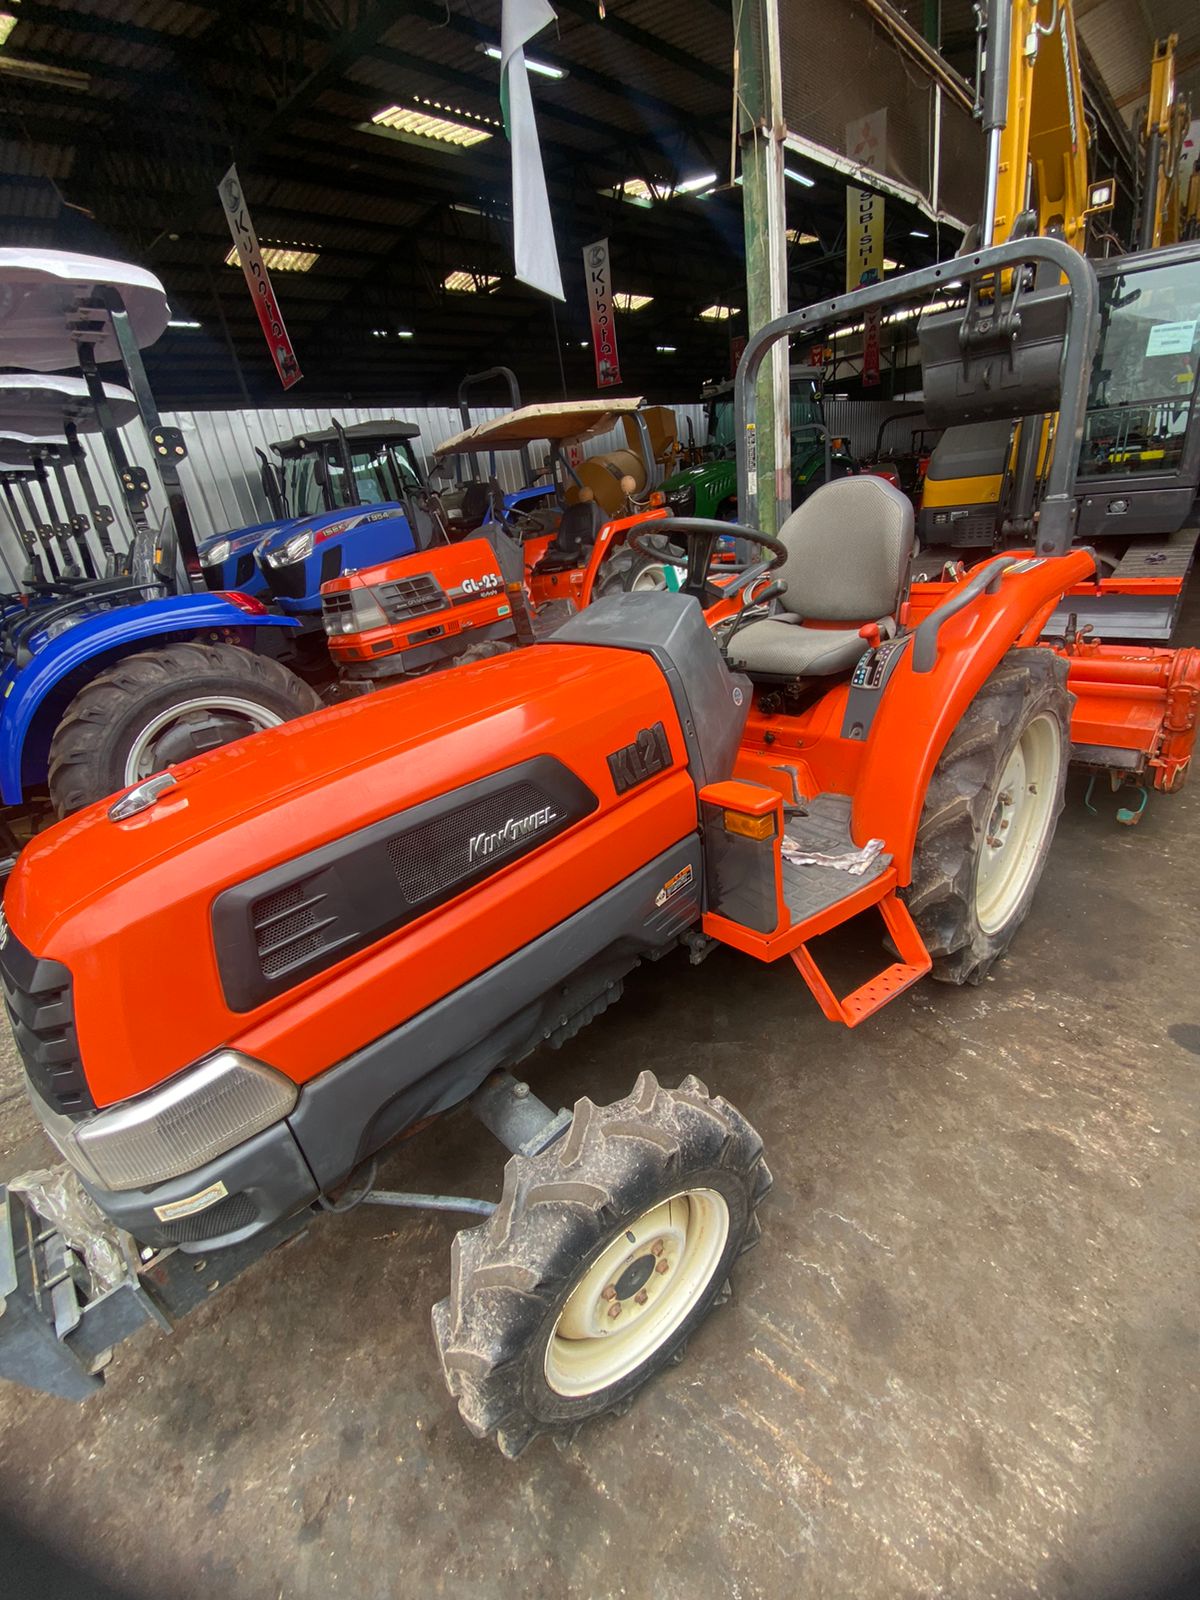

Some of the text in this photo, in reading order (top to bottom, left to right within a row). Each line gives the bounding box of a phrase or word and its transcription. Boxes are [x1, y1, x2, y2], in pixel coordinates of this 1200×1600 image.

[235, 210, 282, 338] Kubota
[591, 268, 611, 354] Kubota
[462, 573, 498, 594] GL-25
[607, 721, 673, 796] KL21
